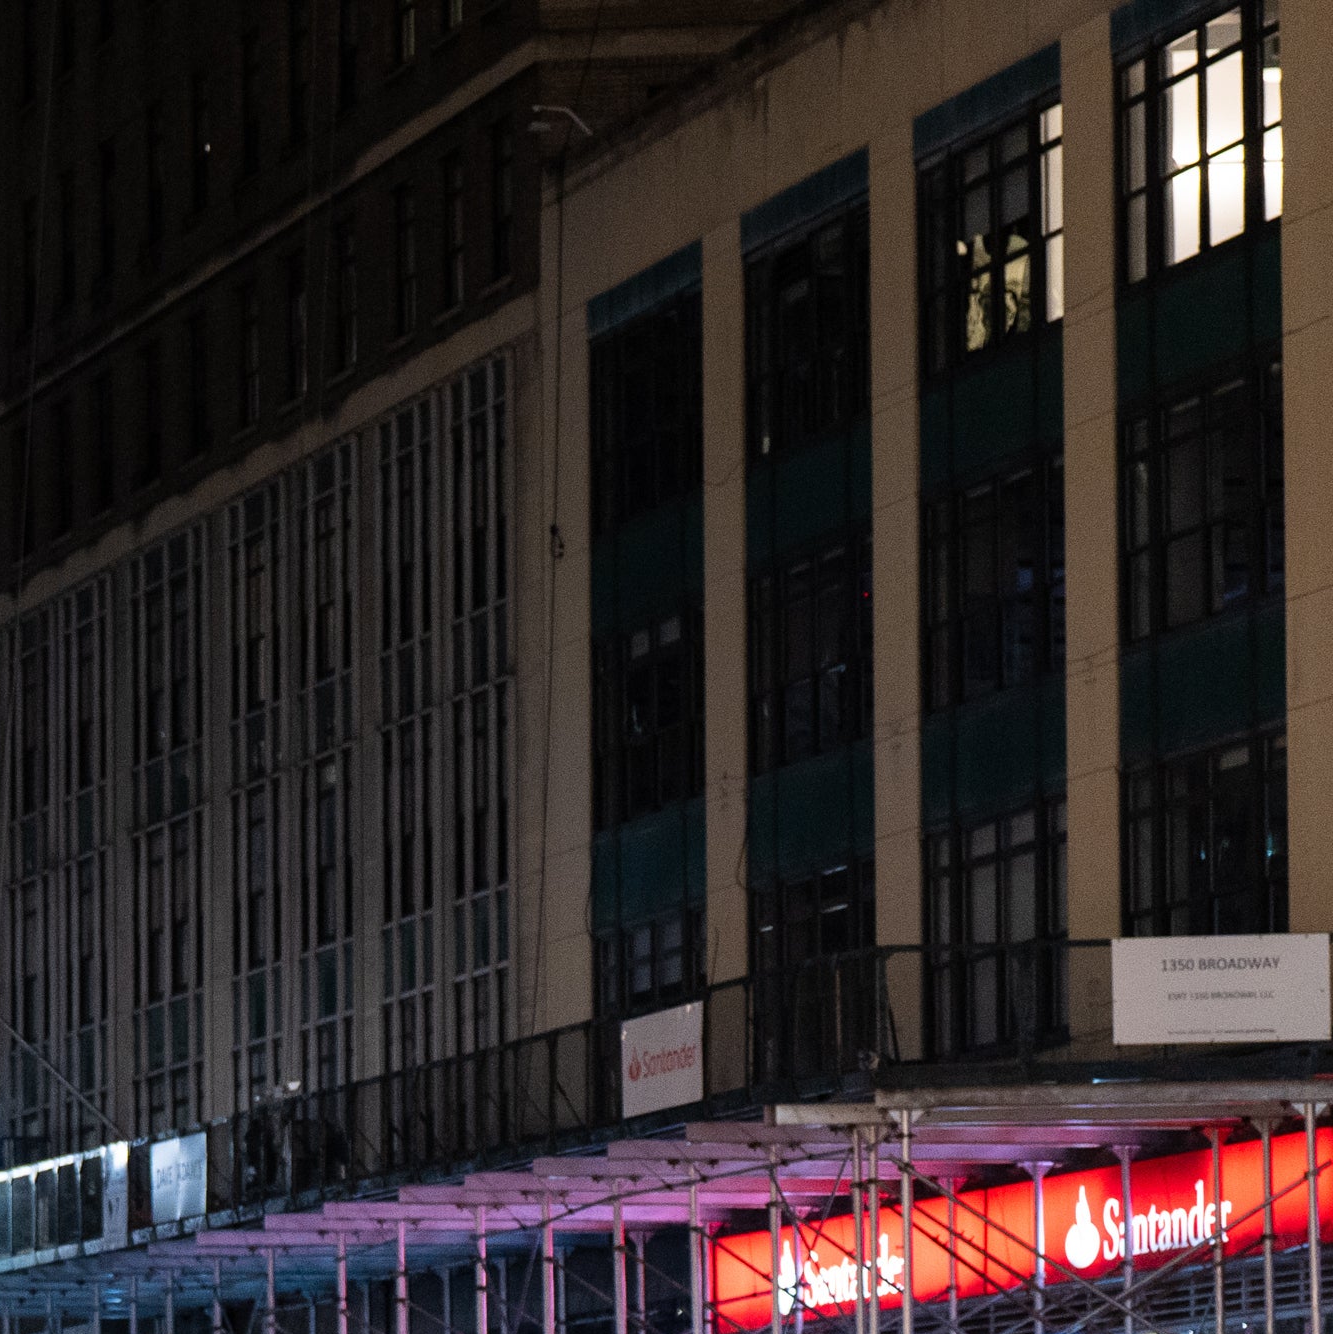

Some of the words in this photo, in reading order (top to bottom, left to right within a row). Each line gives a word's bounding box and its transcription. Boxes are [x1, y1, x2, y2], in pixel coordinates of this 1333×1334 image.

[1162, 958, 1195, 972] 1350
[1198, 956, 1280, 970] BROADWAY
[643, 1045, 696, 1078] Santander
